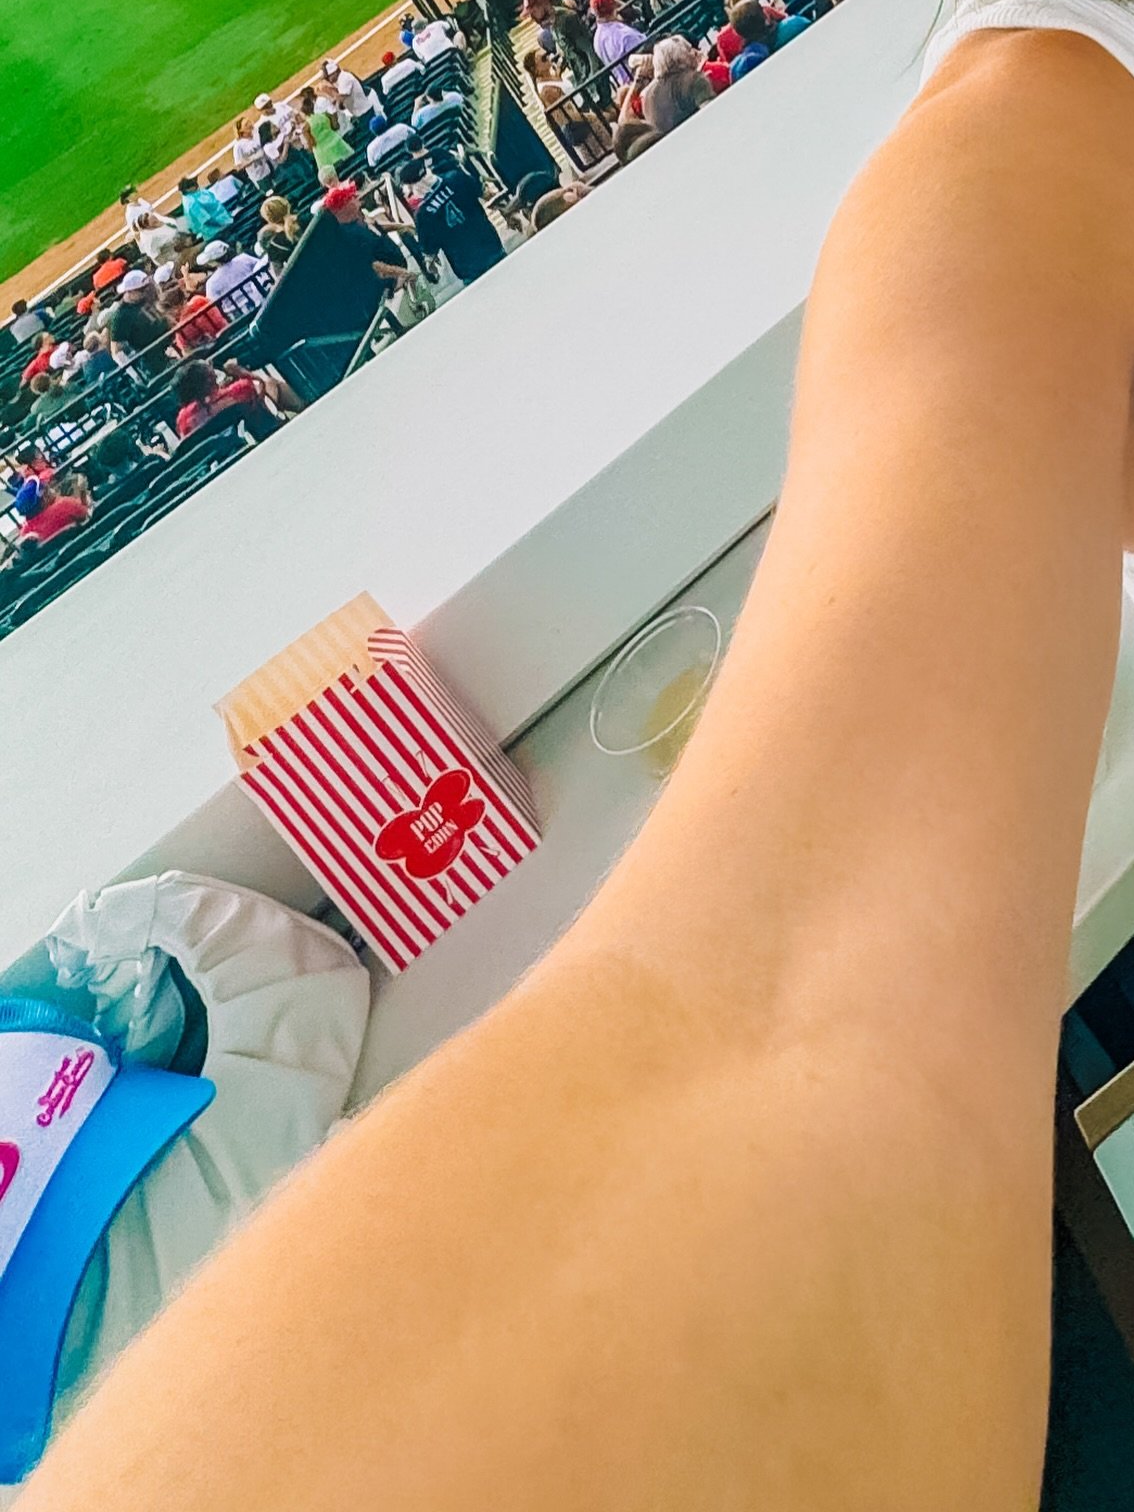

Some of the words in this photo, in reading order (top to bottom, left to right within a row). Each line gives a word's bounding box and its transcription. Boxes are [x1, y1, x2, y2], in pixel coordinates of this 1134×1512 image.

[426, 185, 455, 214] SNELL
[445, 199, 466, 228] 4
[410, 801, 444, 842] POP
[424, 819, 459, 854] CORN
